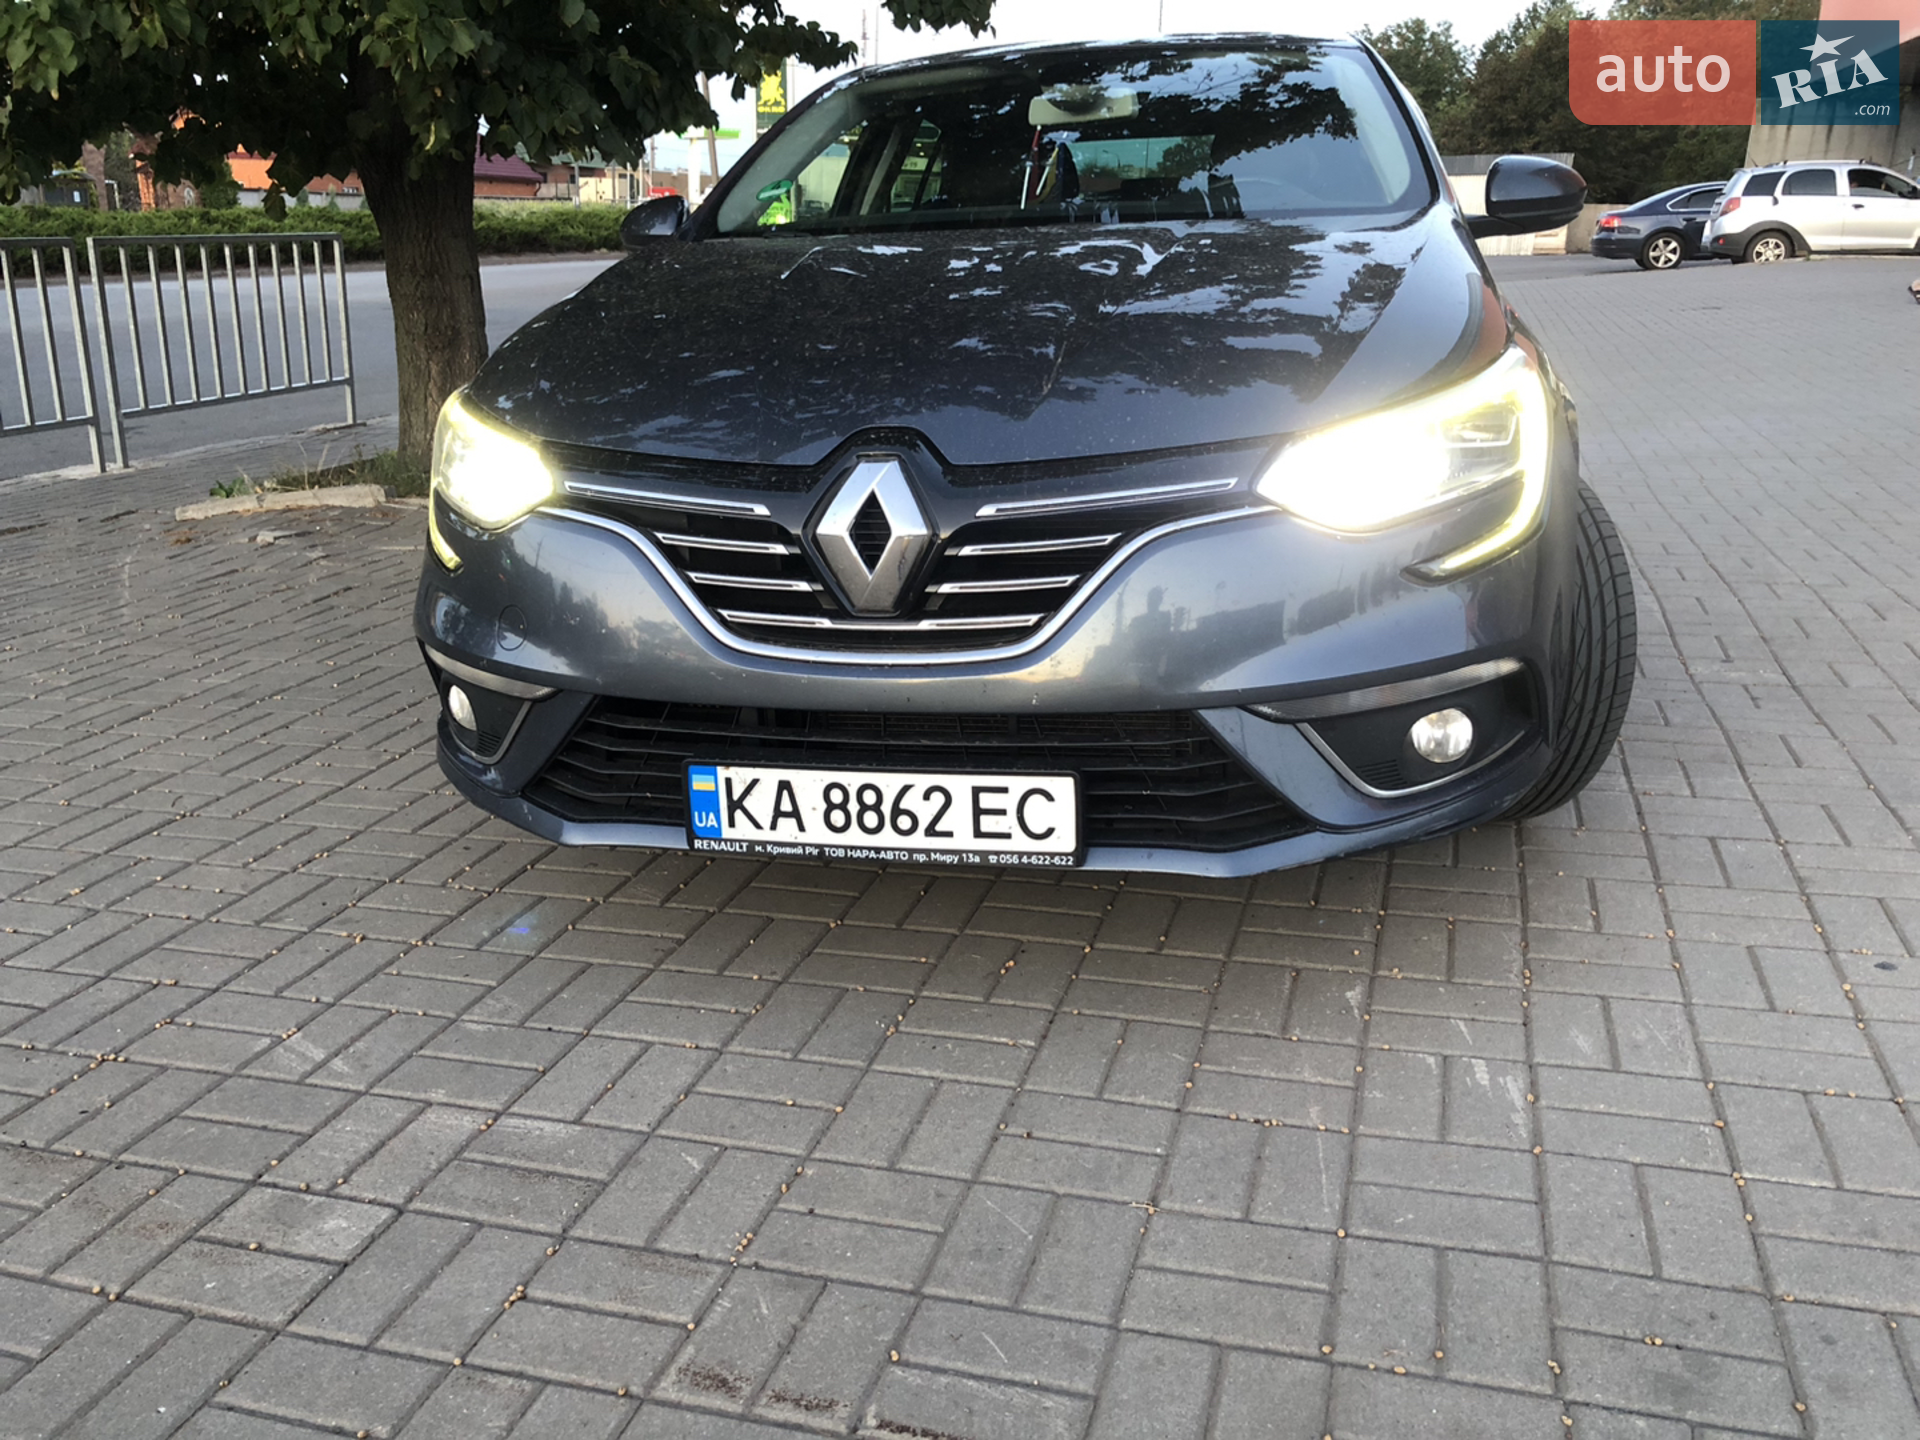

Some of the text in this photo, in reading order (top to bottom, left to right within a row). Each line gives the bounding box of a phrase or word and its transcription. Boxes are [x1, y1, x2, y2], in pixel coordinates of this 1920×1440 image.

[694, 811, 719, 829] UA
[724, 777, 1056, 841] KA 8862 EC
[694, 839, 749, 853] RENAULT
[766, 843, 804, 856] Кривий
[823, 847, 845, 858] ТОВ
[847, 849, 909, 861] НАРА-АВТО
[912, 853, 929, 863] пр.
[930, 852, 960, 864] Миру
[1021, 855, 1074, 866] 4-622-622
